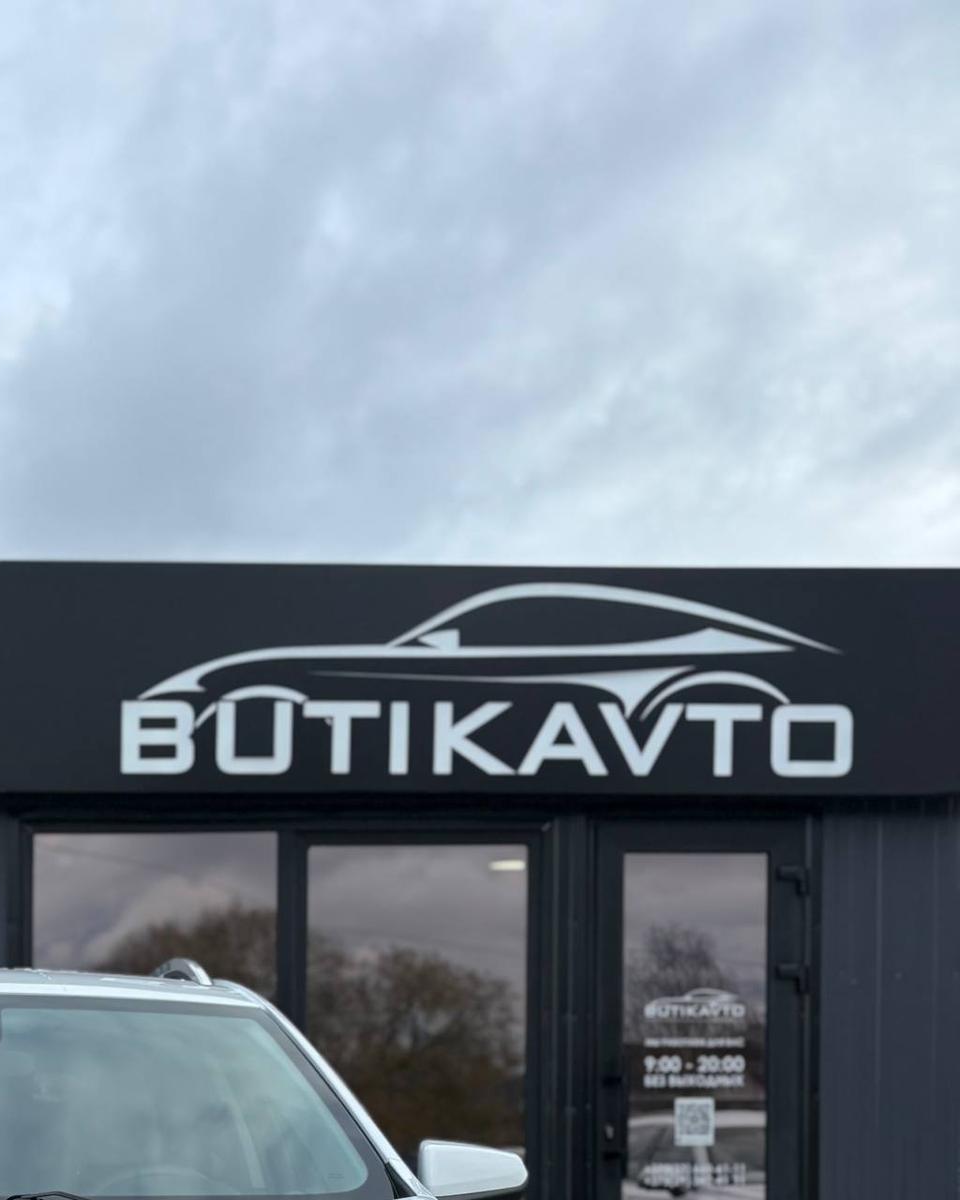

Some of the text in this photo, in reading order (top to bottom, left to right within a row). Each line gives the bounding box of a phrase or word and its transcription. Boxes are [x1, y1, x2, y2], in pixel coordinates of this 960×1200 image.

[120, 699, 854, 777] BUTIKAVTO
[644, 1004, 745, 1019] BUTIKAVTO
[643, 1055, 682, 1073] 9:00
[697, 1055, 746, 1073] 20:00
